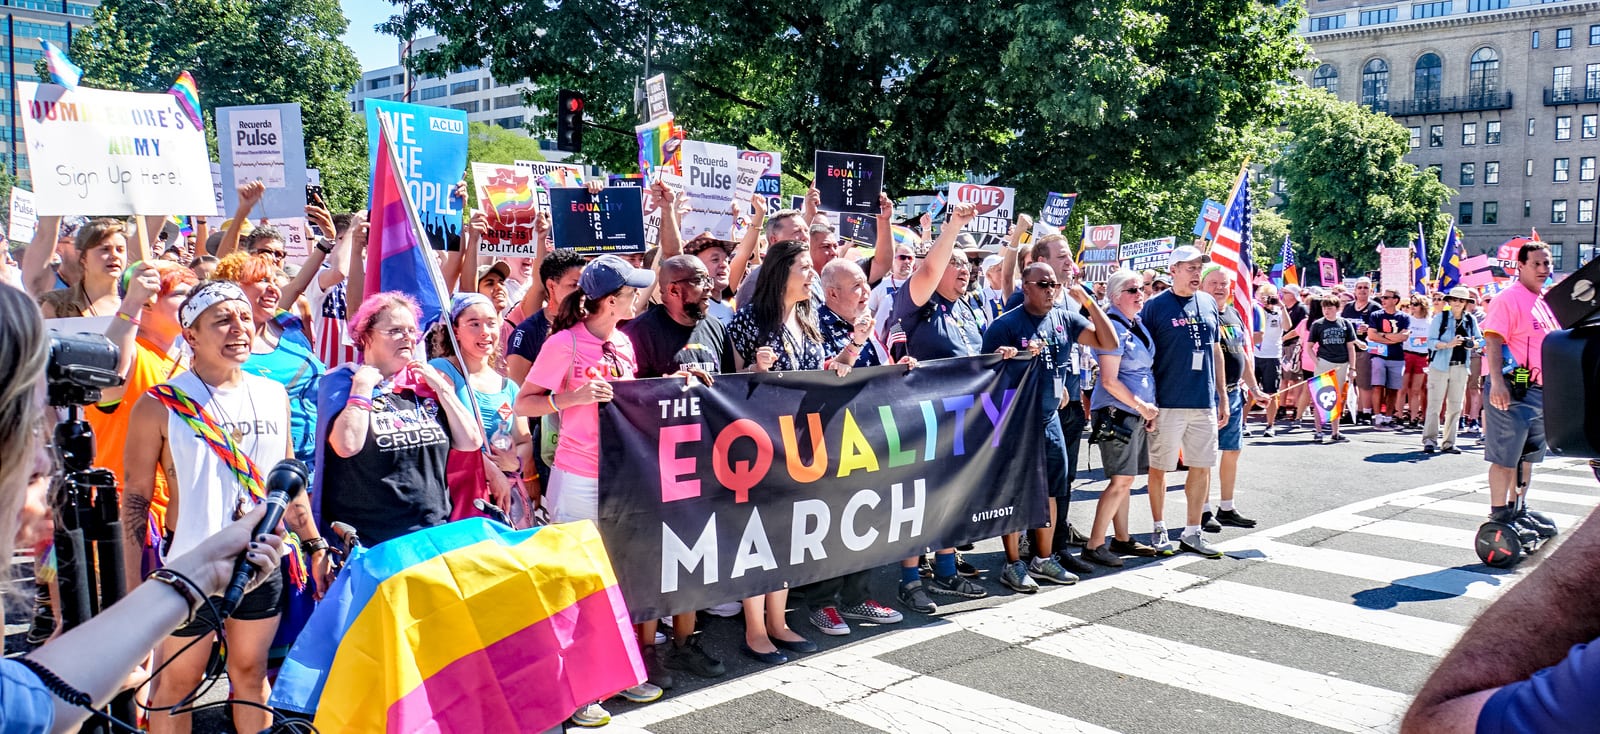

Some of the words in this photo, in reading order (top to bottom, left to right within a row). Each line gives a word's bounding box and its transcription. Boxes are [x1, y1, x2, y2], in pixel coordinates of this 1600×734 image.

[239, 119, 272, 129] Recuerda
[432, 119, 462, 132] ACLU
[237, 129, 277, 146] Pulse
[108, 136, 161, 157] ARMY
[394, 145, 423, 178] HE
[693, 154, 728, 168] Recuerda
[690, 165, 731, 190] Pulse
[827, 167, 873, 179] EQUALITY
[56, 164, 98, 199] Sign
[108, 165, 132, 194] Up
[757, 178, 779, 193] AYS
[406, 181, 457, 216] OPLE
[961, 187, 1000, 207] LOVE
[1052, 198, 1070, 208] LOVE
[997, 208, 1008, 218] NO
[1045, 206, 1070, 216] ALWAYS
[1046, 215, 1063, 225] WINS
[1092, 229, 1113, 241] LOVE
[480, 243, 535, 254] POLITICAL
[1122, 239, 1162, 251] MARCHING
[1122, 245, 1159, 258] TOWARDS
[1085, 249, 1116, 262] ALWAYS
[1499, 246, 1518, 259] ST
[1497, 259, 1518, 269] TRU
[659, 399, 701, 419] THE
[375, 428, 447, 448] CRUSH
[659, 388, 1017, 503] EQUALITY
[971, 505, 1015, 524] 6/11/2017
[660, 478, 927, 594] MARCH
